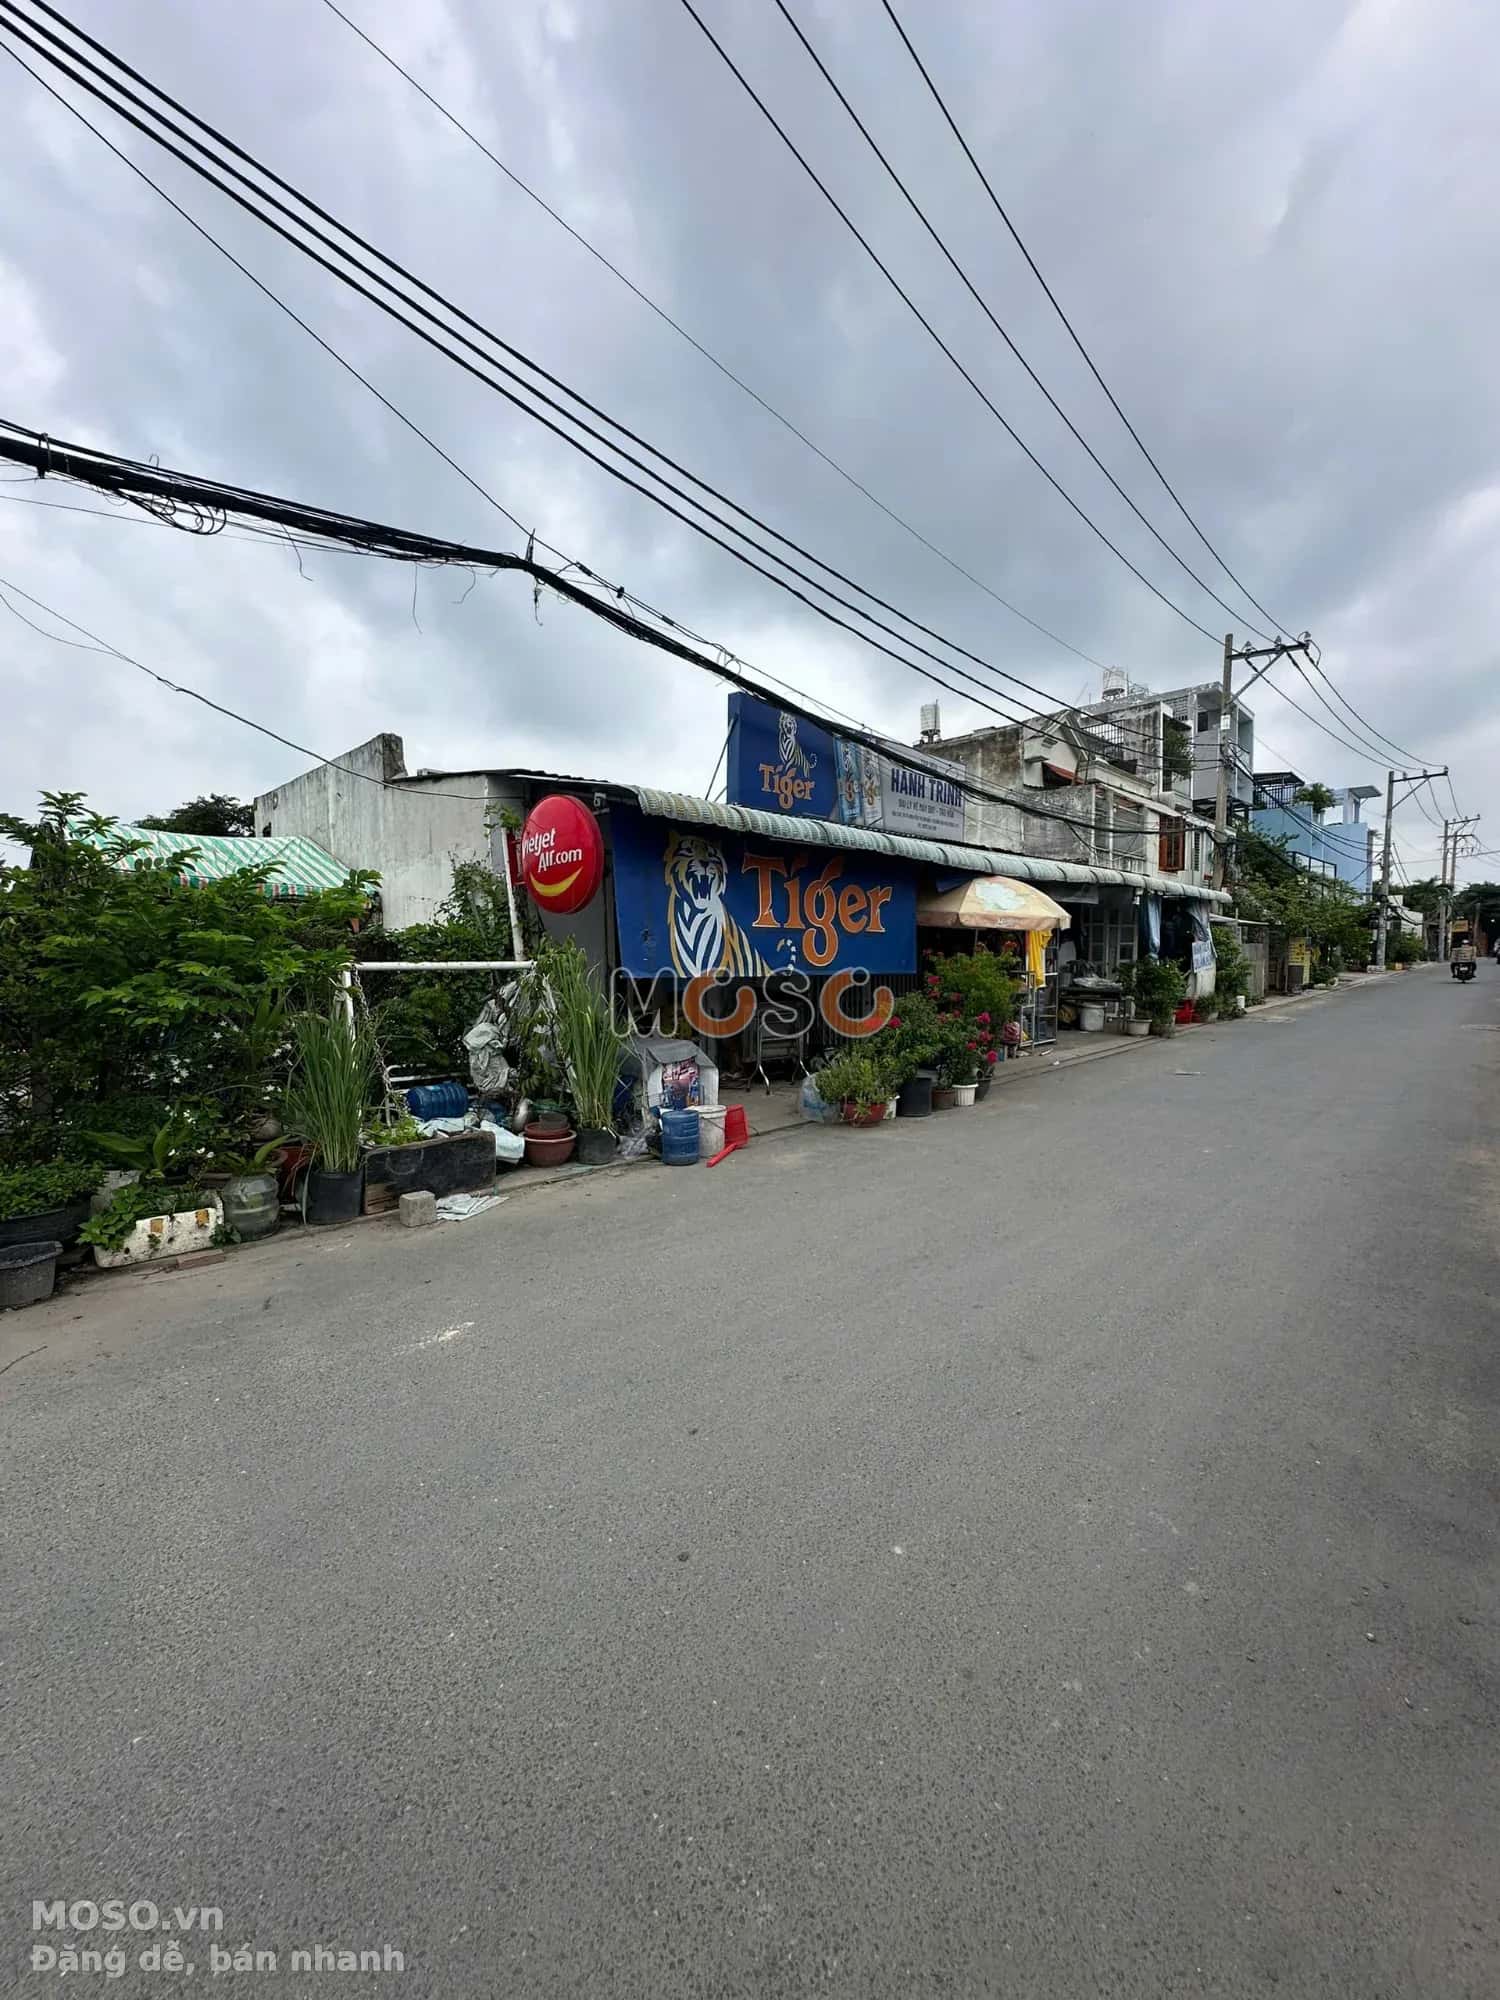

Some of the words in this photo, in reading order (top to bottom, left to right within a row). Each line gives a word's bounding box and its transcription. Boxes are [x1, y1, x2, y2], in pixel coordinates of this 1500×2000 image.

[759, 763, 816, 809] Tiger
[537, 848, 582, 873] Air.com
[741, 852, 893, 967] Tiger
